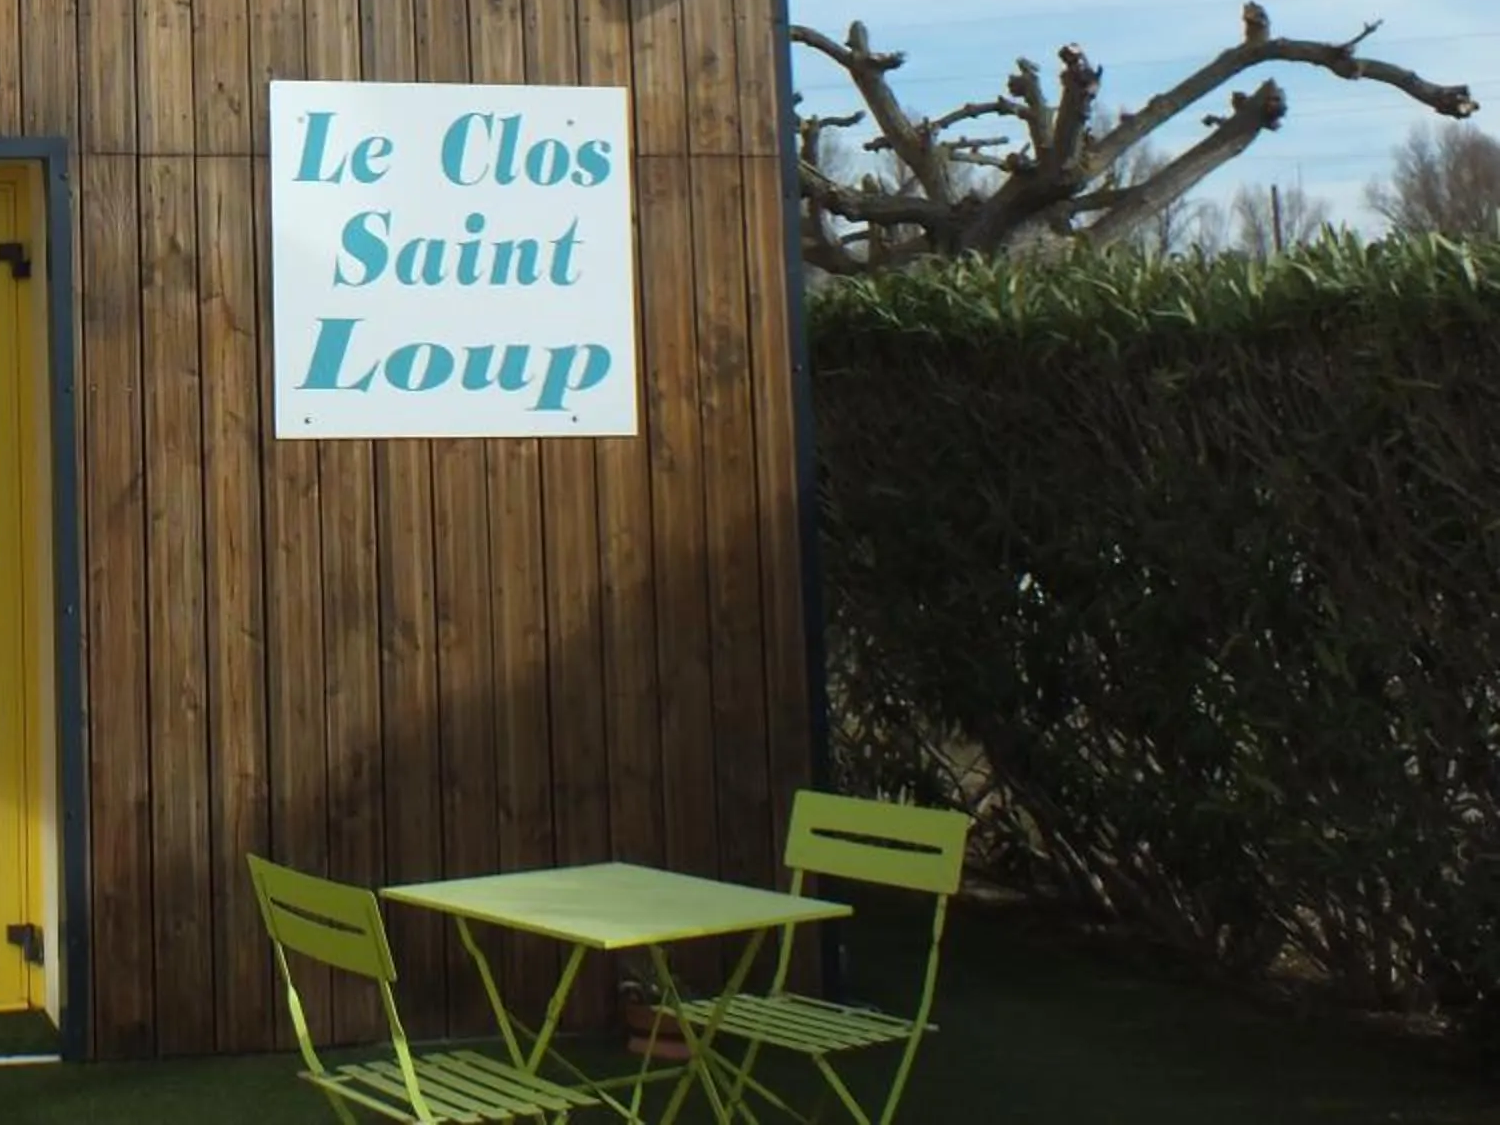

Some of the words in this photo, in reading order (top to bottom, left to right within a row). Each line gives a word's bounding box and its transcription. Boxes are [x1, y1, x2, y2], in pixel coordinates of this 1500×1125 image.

[292, 111, 394, 184] Le
[441, 112, 612, 187] Clos
[333, 210, 584, 287] Saint
[293, 318, 612, 412] Loup
